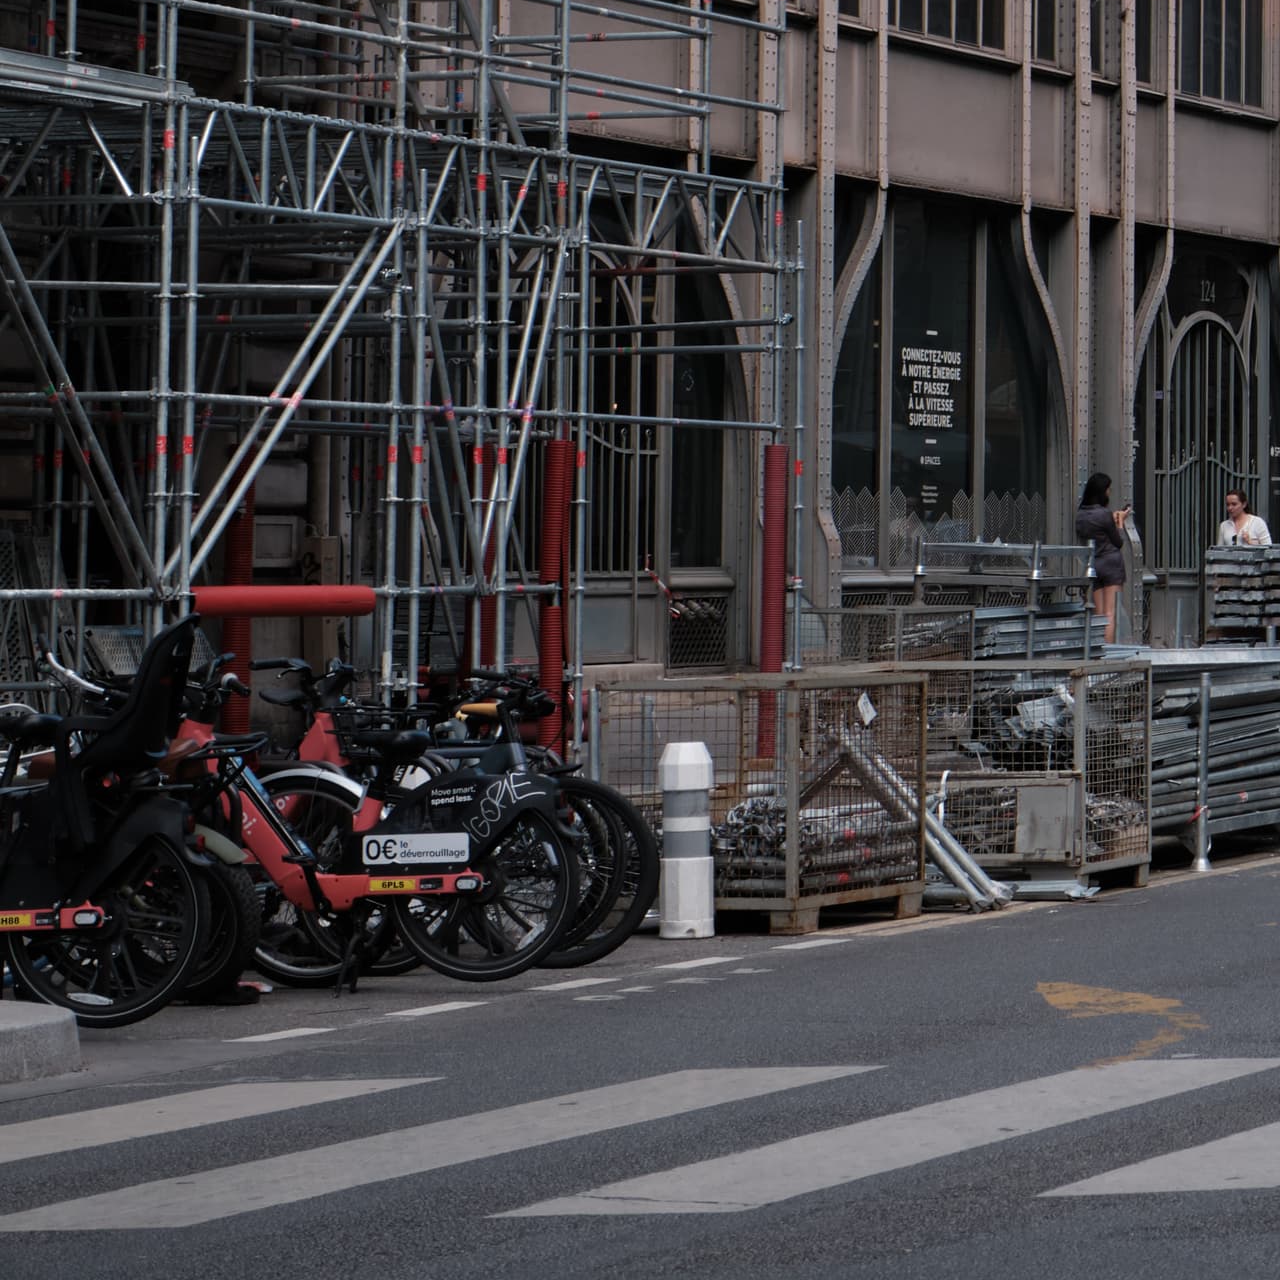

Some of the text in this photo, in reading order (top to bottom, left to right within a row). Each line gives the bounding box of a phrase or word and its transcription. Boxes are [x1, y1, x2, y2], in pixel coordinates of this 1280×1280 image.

[1201, 280, 1216, 304] 124
[901, 347, 961, 365] CONNECTEZ-VOUS
[902, 360, 961, 381] À NOTRE ÉNERGIE
[913, 381, 950, 396] ET PASSEZ
[908, 393, 954, 412] À LA VITESSE
[909, 411, 953, 428] SUPÉRIEURE.
[431, 788, 451, 797] Move
[431, 795, 473, 806] spend less.
[366, 839, 398, 860] 0€
[400, 840, 409, 848] le
[400, 848, 466, 859] déverrouillage
